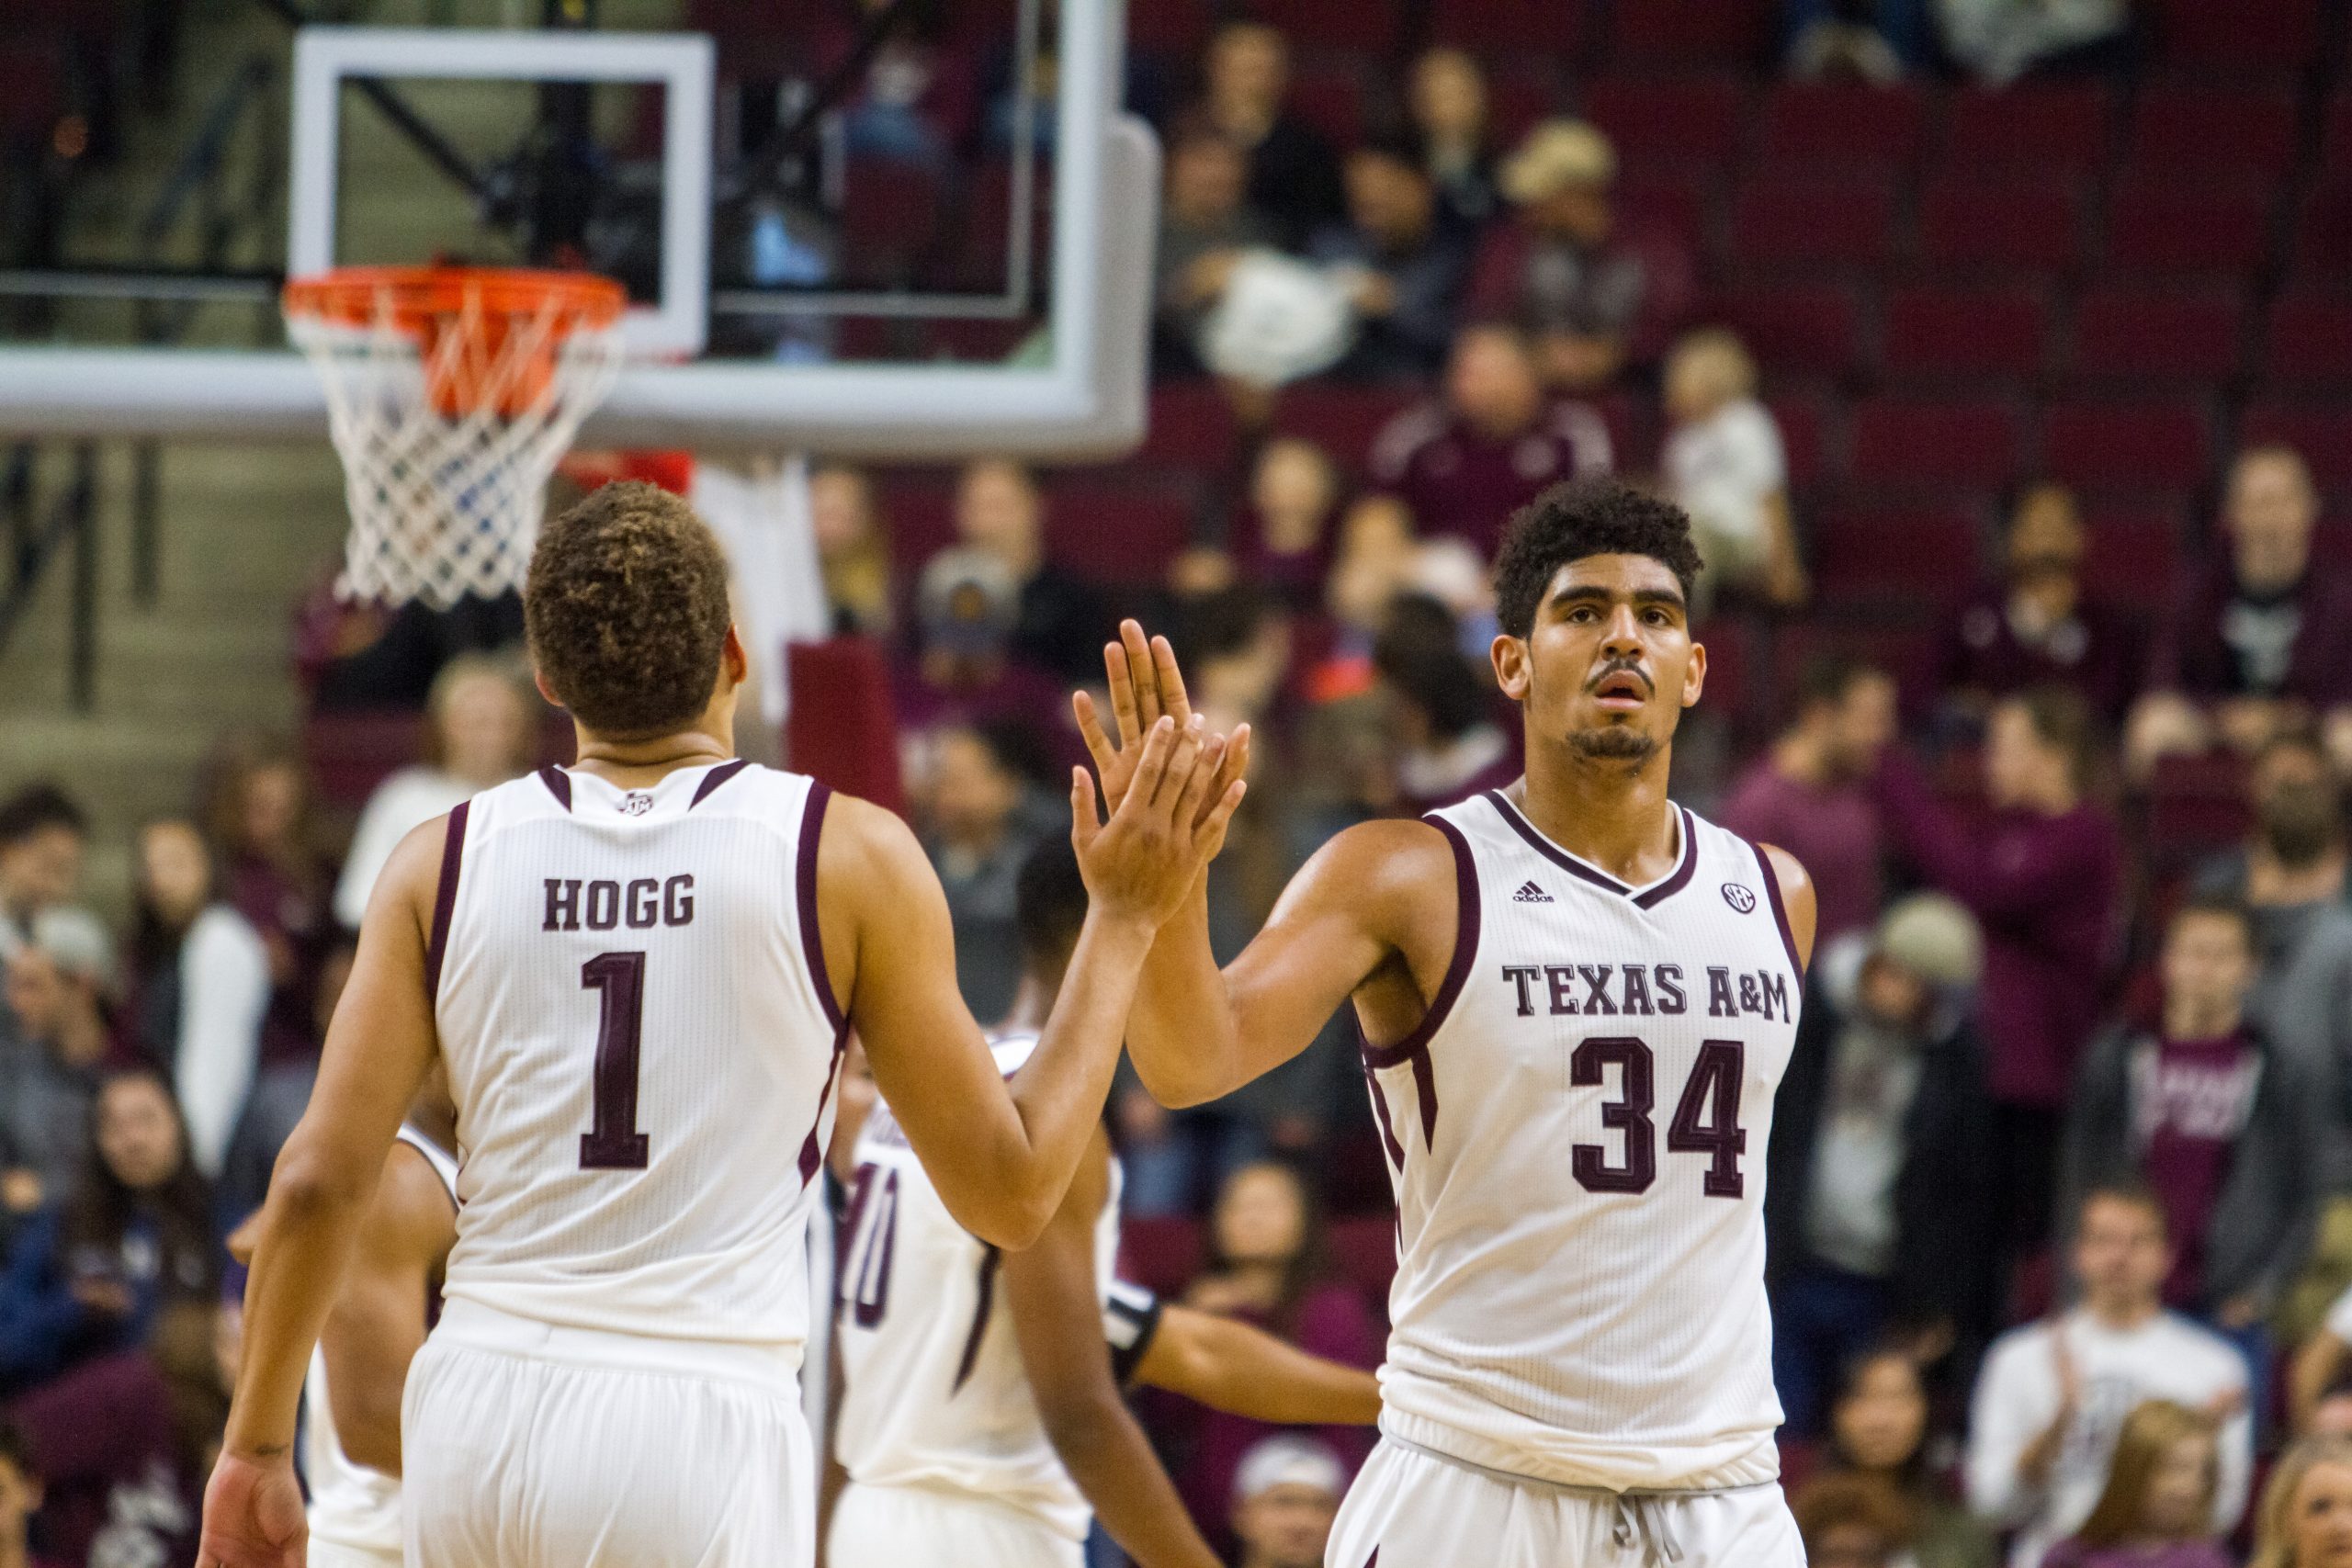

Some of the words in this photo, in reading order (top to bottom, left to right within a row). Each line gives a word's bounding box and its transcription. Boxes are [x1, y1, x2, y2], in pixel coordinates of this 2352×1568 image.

[542, 874, 695, 931] HOGG
[1512, 894, 1555, 903] adidas
[1723, 884, 1755, 912] SEC
[1502, 964, 1688, 1017] TEXAS
[1707, 965, 1791, 1024] A&M
[579, 951, 650, 1170] 1
[1571, 1037, 1747, 1200] 34
